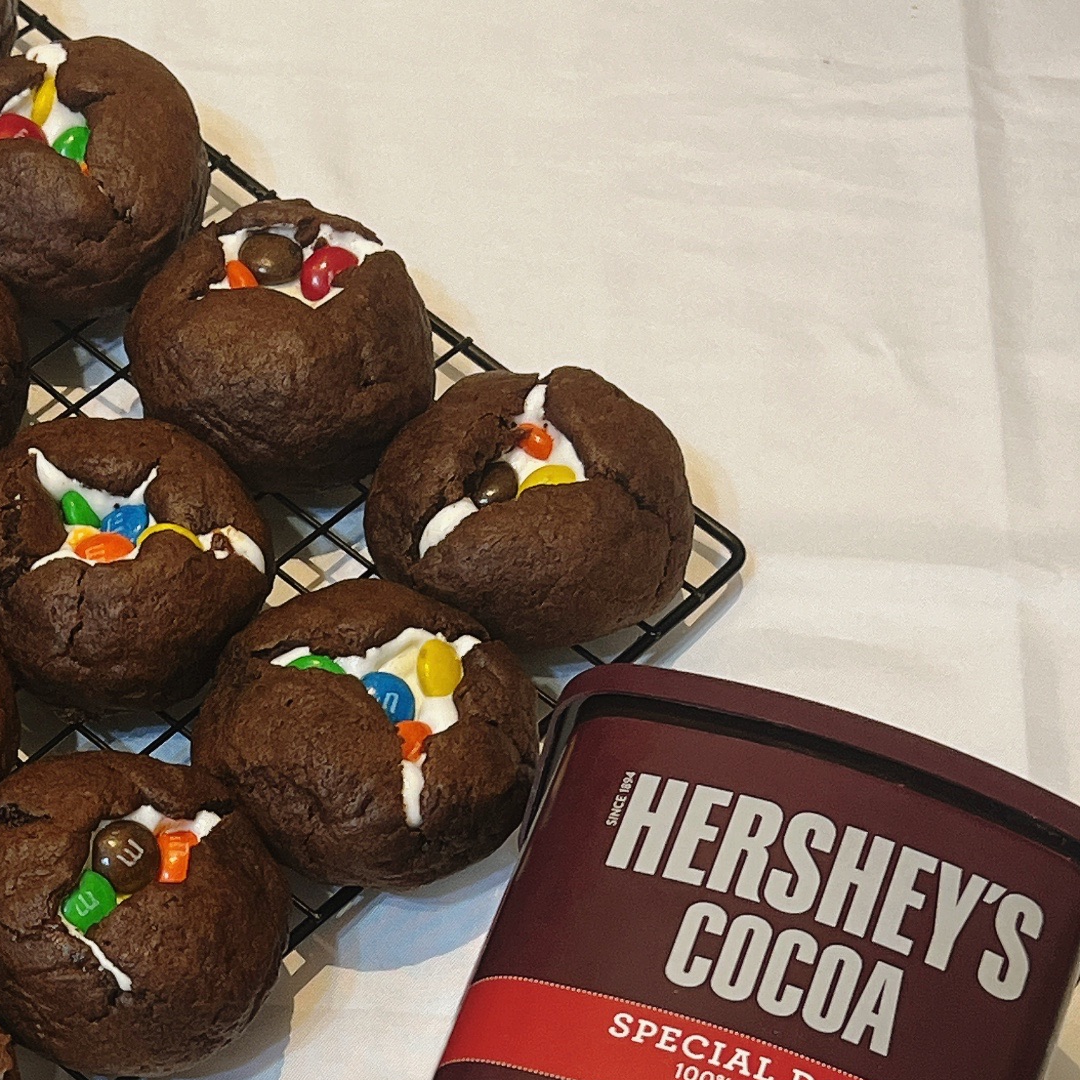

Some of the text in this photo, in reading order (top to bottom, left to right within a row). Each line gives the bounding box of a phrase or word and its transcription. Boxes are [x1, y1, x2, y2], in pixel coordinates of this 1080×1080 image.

[605, 771, 637, 826] SINCE 1894
[605, 773, 1045, 1001] HERSHEY'S
[665, 901, 904, 1057] COCOA
